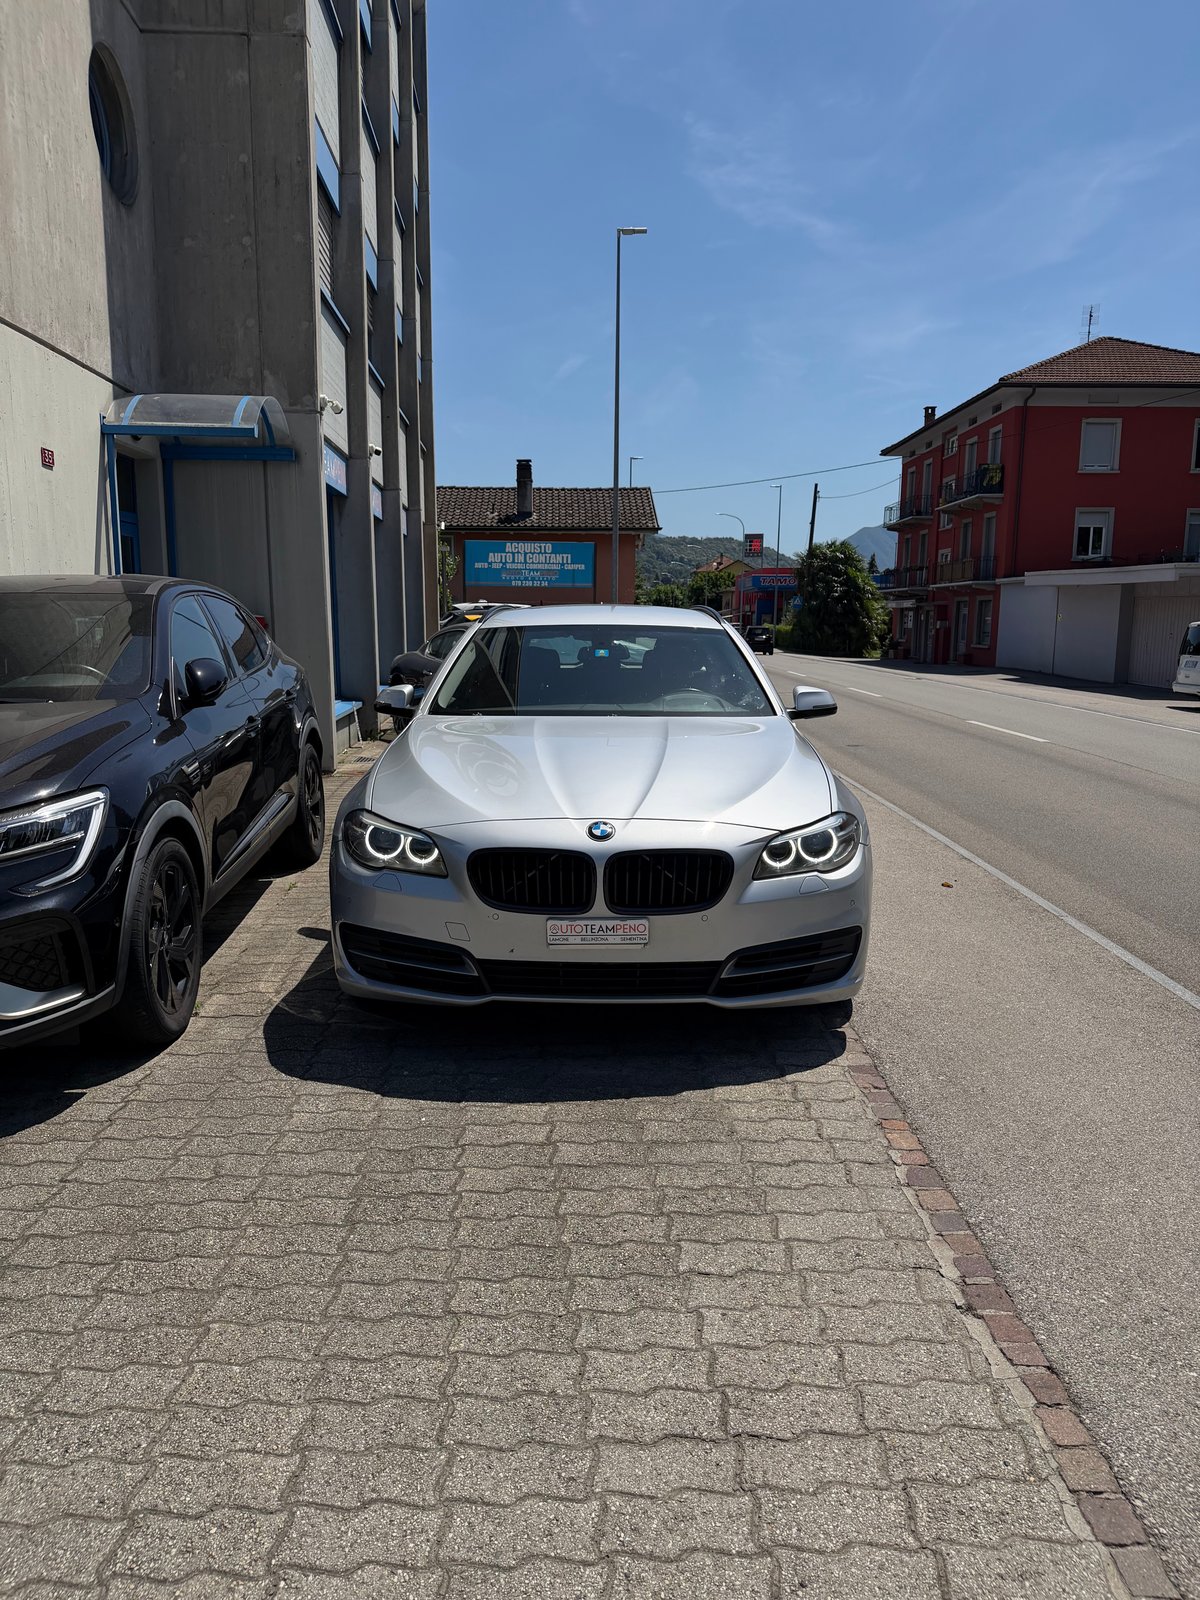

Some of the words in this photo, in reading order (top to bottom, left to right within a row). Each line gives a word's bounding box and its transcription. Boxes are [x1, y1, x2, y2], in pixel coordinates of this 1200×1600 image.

[44, 450, 53, 463] 35
[505, 543, 552, 553] ACQUISTO
[488, 553, 512, 562] AUTO
[514, 553, 524, 562] IN
[526, 553, 571, 563] CONTANTI
[760, 576, 797, 585] TAMO
